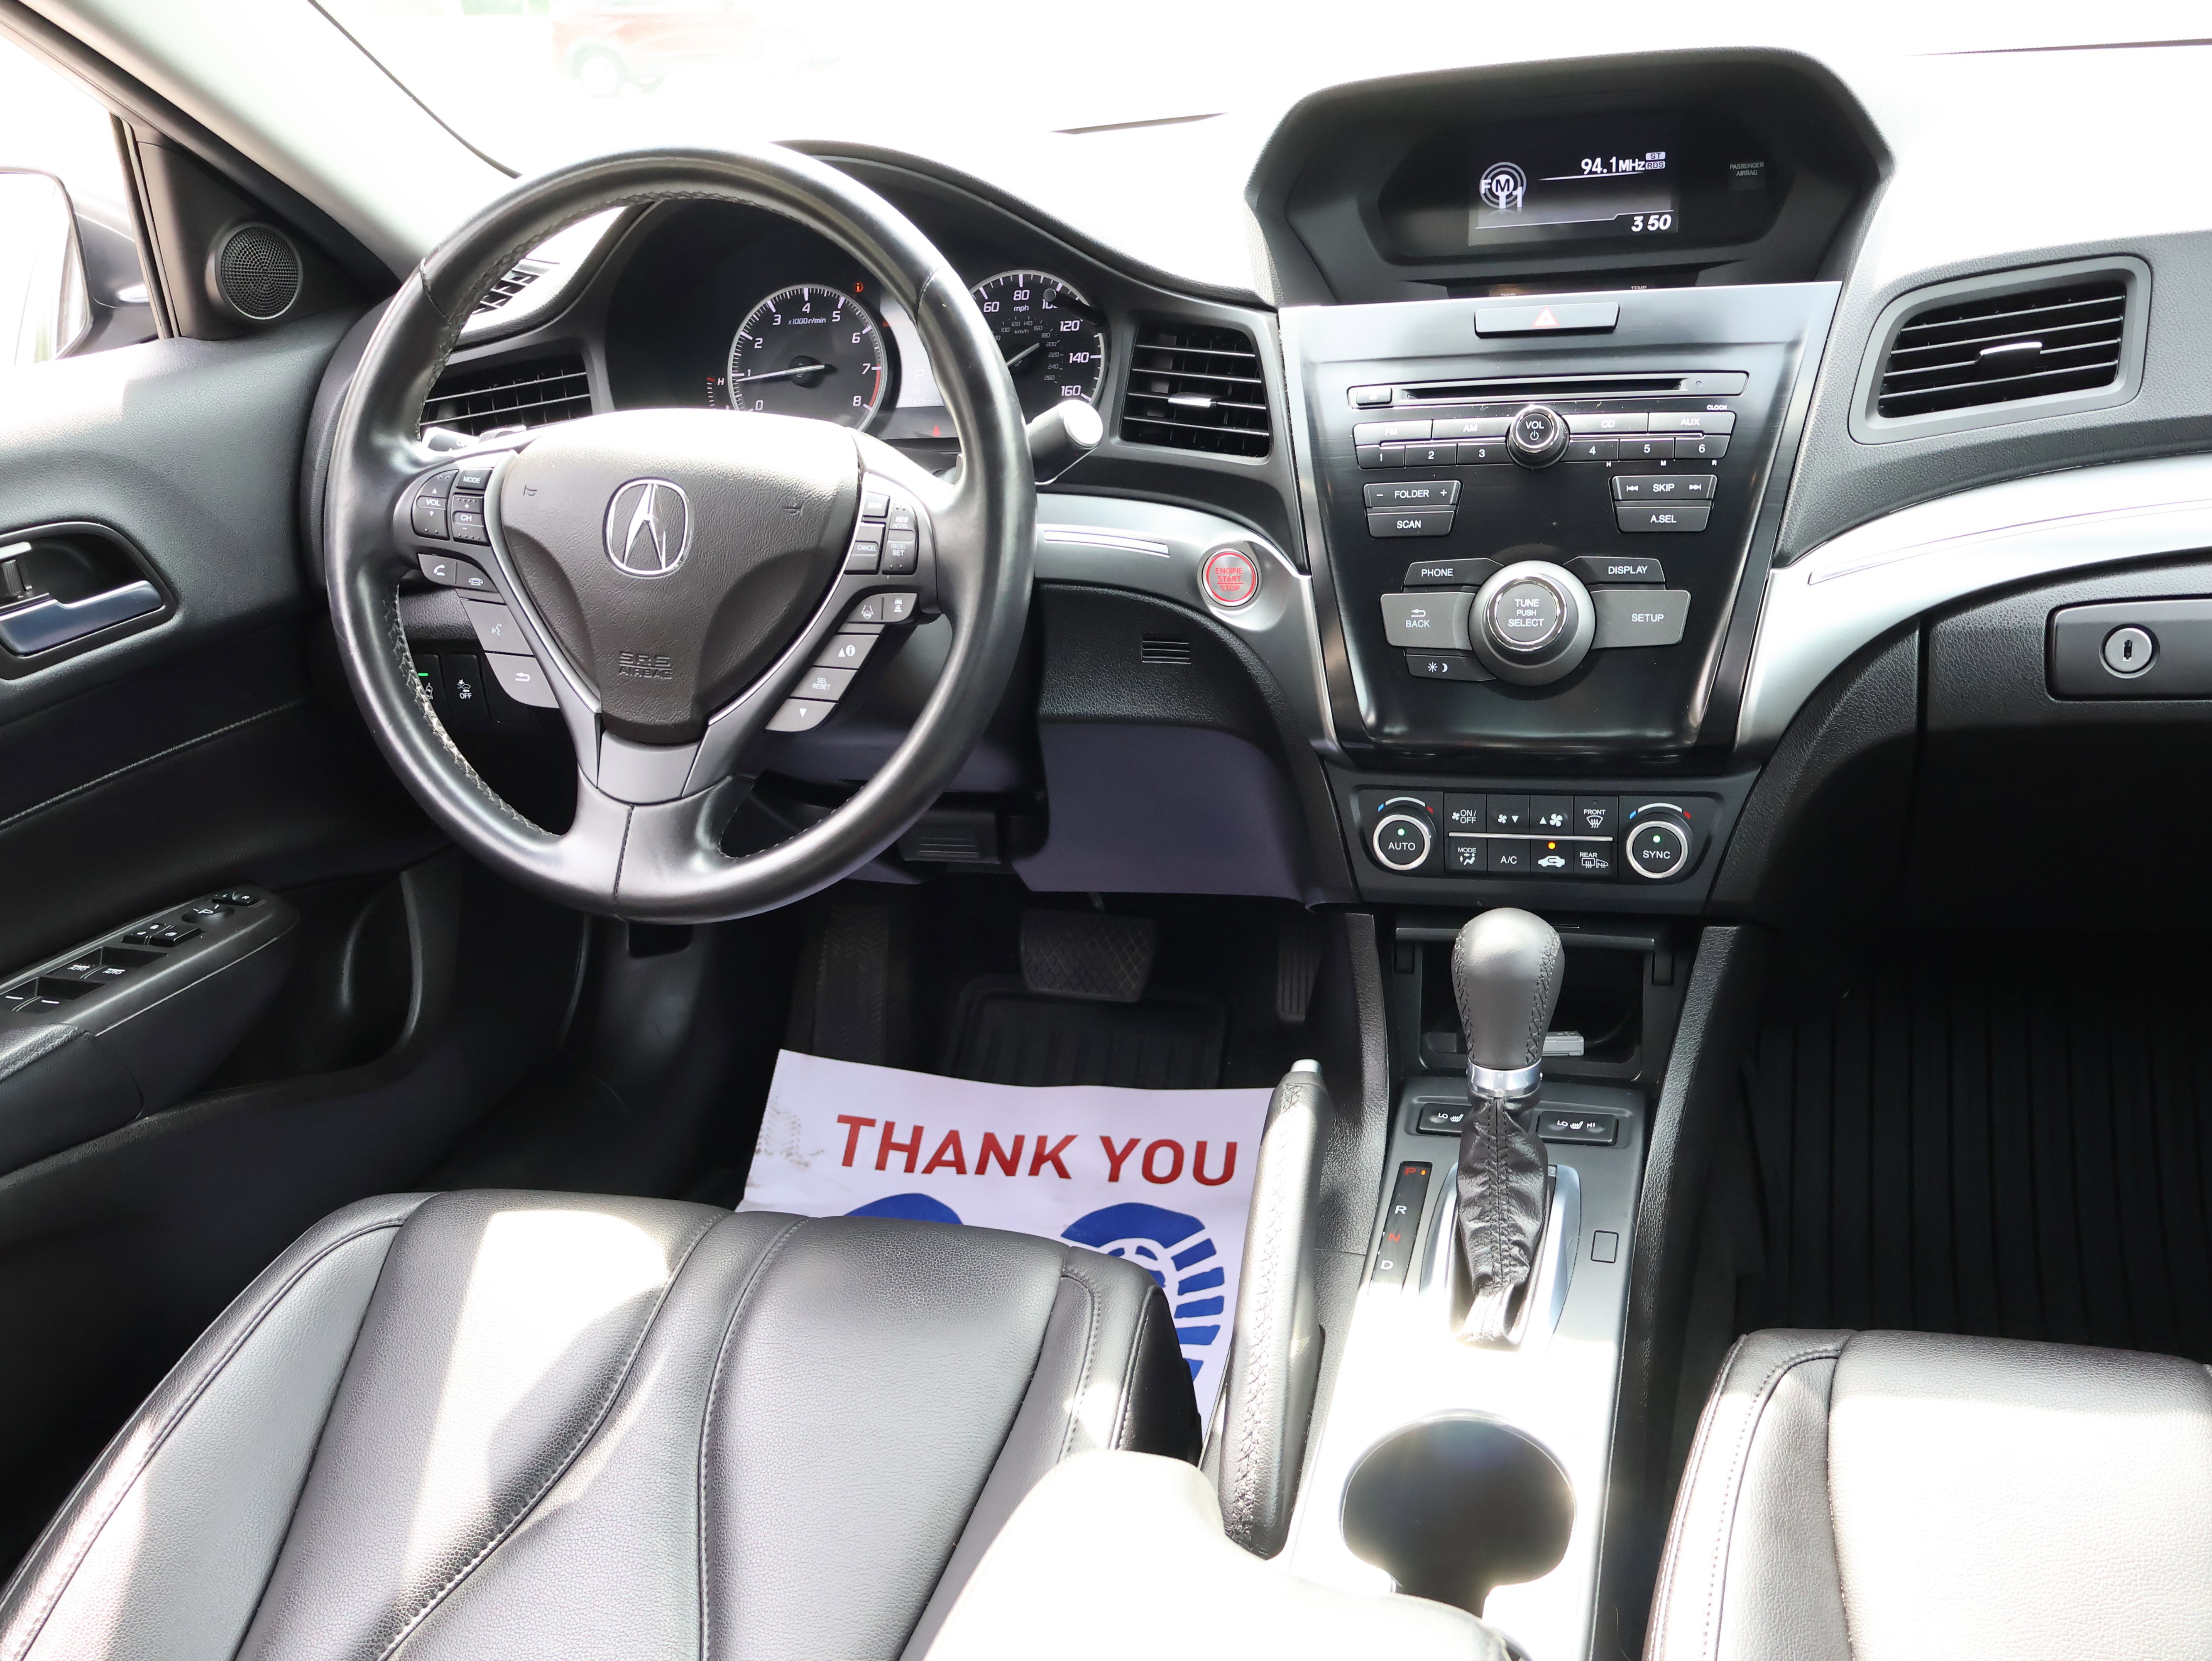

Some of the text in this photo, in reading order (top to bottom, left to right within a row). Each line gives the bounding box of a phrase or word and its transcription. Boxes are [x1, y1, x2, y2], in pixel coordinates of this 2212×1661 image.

[1013, 290, 1030, 301] 80
[802, 303, 811, 314] 4
[984, 301, 1000, 313] 60
[1013, 304, 1029, 312] mph
[772, 314, 781, 325] 3
[832, 311, 841, 322] 5
[1060, 320, 1079, 331] 120
[852, 332, 861, 343] 6
[754, 338, 763, 348] 2
[1069, 352, 1089, 363] 140
[862, 363, 871, 375] 7
[914, 368, 925, 382] P
[1061, 385, 1081, 397] 160
[755, 400, 764, 410] 0
[852, 395, 861, 406] 8
[1525, 421, 1544, 430] VOL
[1601, 420, 1615, 429] CD
[1680, 418, 1700, 426] AUX
[1384, 427, 1397, 436] FM
[1463, 424, 1478, 432] AM
[1478, 449, 1485, 458] 3
[1589, 446, 1596, 455] 4
[1644, 444, 1651, 453] 5
[1698, 444, 1705, 453] 6
[1379, 453, 1383, 462] 1
[1428, 451, 1434, 460] 2
[463, 475, 481, 484] MODE
[1653, 483, 1675, 492] SKIP
[1394, 489, 1429, 499] FOLDER
[426, 498, 441, 507] VOL
[1650, 514, 1677, 523] A.SEL
[1397, 520, 1422, 529] SCAN
[1421, 568, 1453, 577] PHONE
[1608, 565, 1648, 576] DISPLAY
[1515, 598, 1540, 608] TUNE
[1516, 609, 1537, 617] PUSH
[1631, 613, 1664, 623] SETUP
[1405, 619, 1430, 628] BACK
[1507, 618, 1545, 628] SELECT
[1459, 816, 1476, 824] OFF
[1387, 841, 1416, 852] AUTO
[1642, 849, 1671, 859] SYNC
[1500, 855, 1517, 865] A/C
[837, 1114, 1238, 1186] THANK YOU
[1405, 1167, 1416, 1176] P
[1394, 1205, 1407, 1215] R
[1387, 1232, 1401, 1242] N
[1380, 1259, 1394, 1270] D
